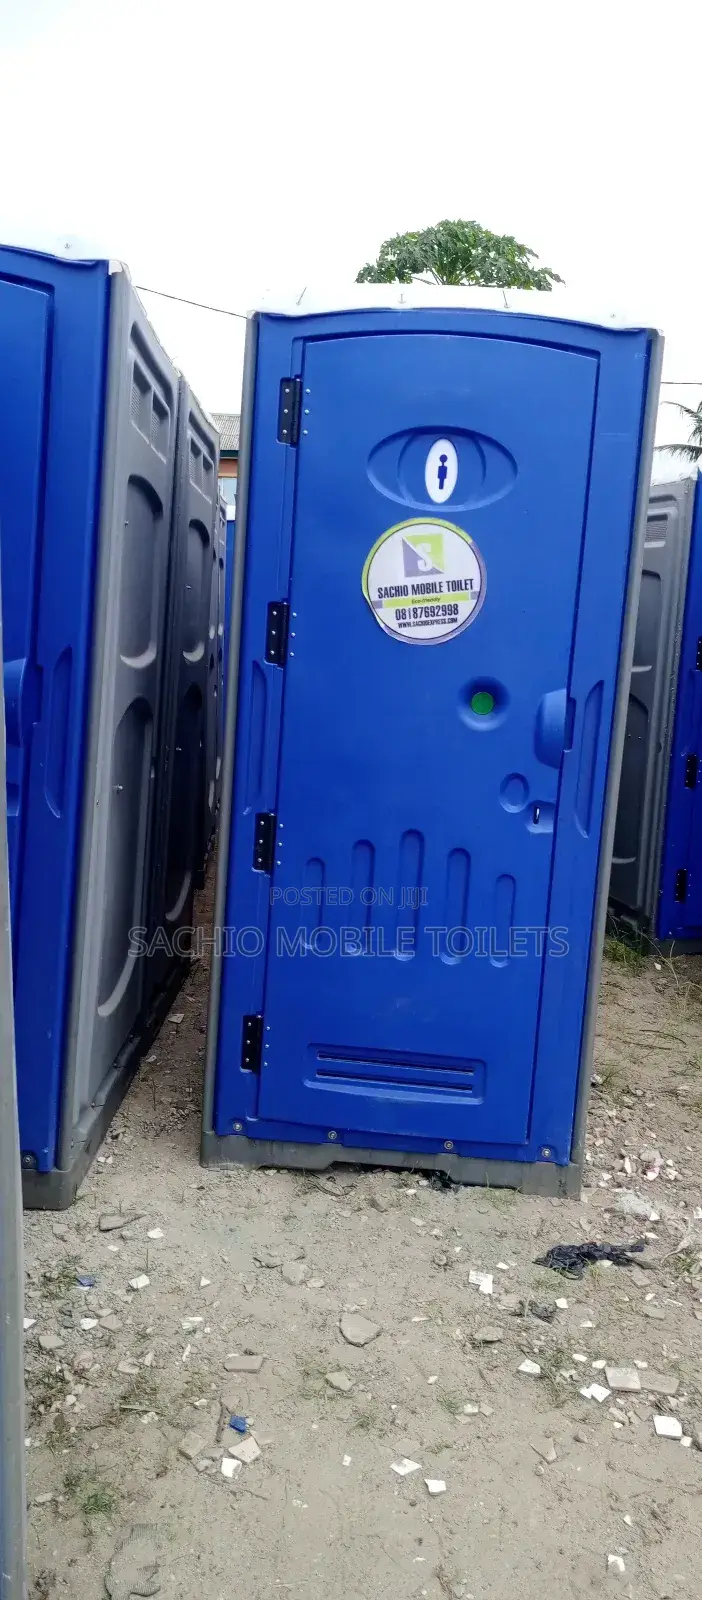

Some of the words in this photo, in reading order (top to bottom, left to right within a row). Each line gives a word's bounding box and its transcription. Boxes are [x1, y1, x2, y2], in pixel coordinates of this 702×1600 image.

[377, 584, 409, 599] SACHIO
[411, 581, 443, 596] MOBILE
[446, 578, 474, 592] TOILET
[395, 603, 459, 621] 08187692998
